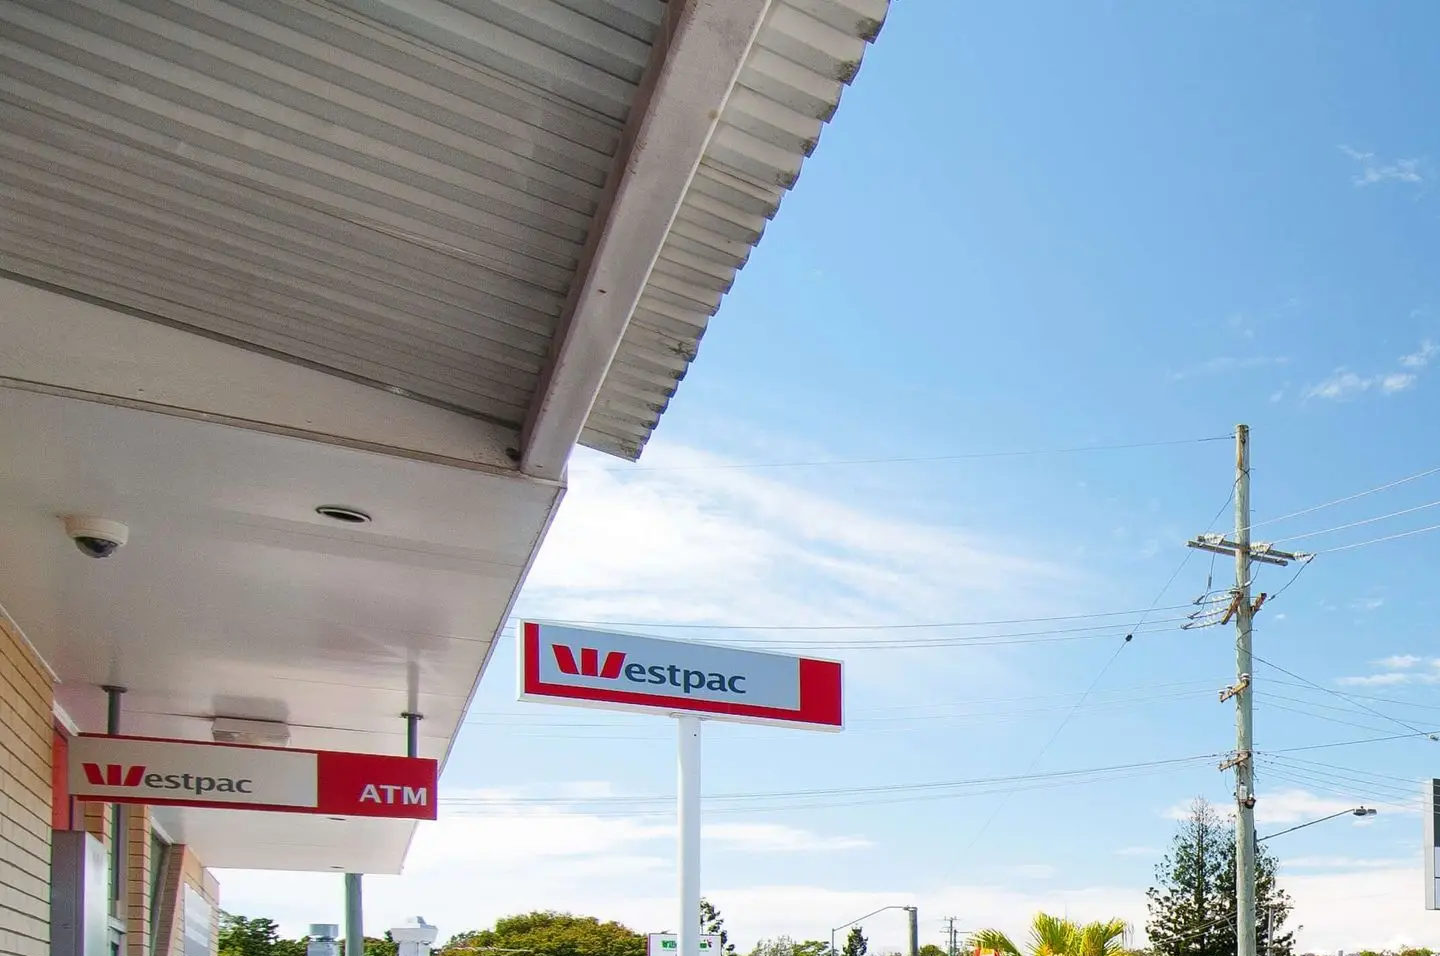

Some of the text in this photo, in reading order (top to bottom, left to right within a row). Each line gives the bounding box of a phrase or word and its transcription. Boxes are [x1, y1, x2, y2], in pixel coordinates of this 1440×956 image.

[552, 643, 746, 693] Westpac
[82, 762, 427, 806] Westpac ATM
